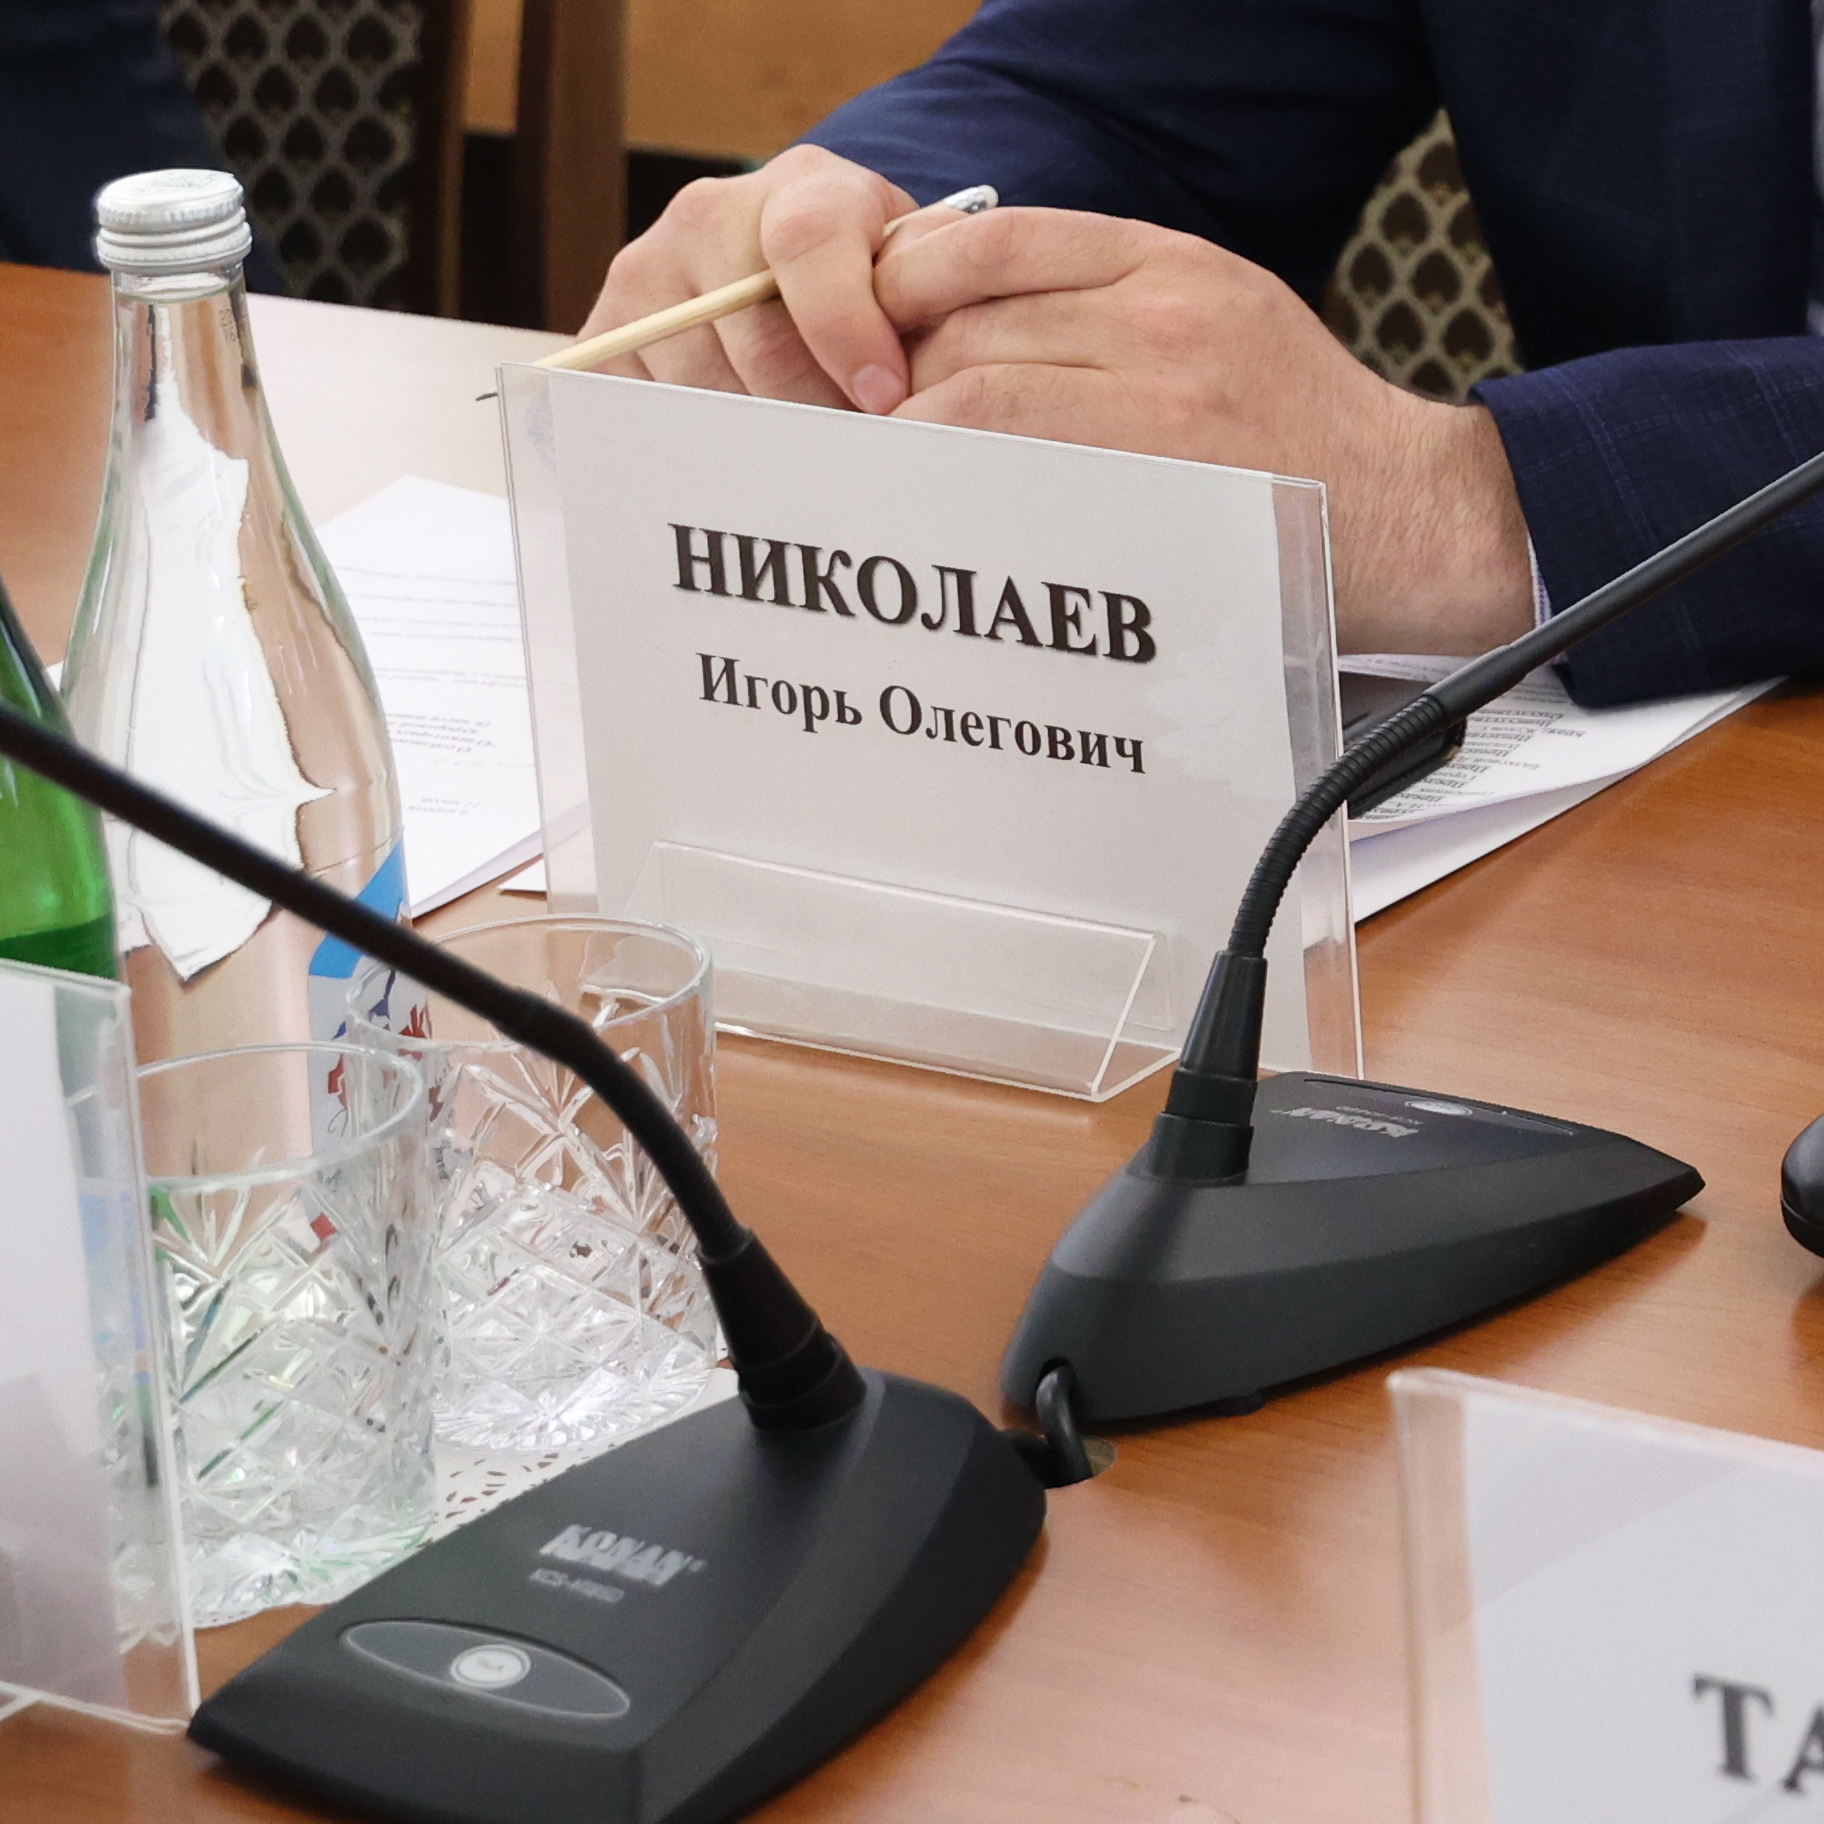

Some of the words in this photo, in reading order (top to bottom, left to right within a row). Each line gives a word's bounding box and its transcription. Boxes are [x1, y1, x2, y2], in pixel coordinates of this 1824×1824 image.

[667, 522, 1158, 665] НИКОЛАЕВ
[695, 651, 864, 735] Игорь
[878, 684, 1147, 775] Олегович
